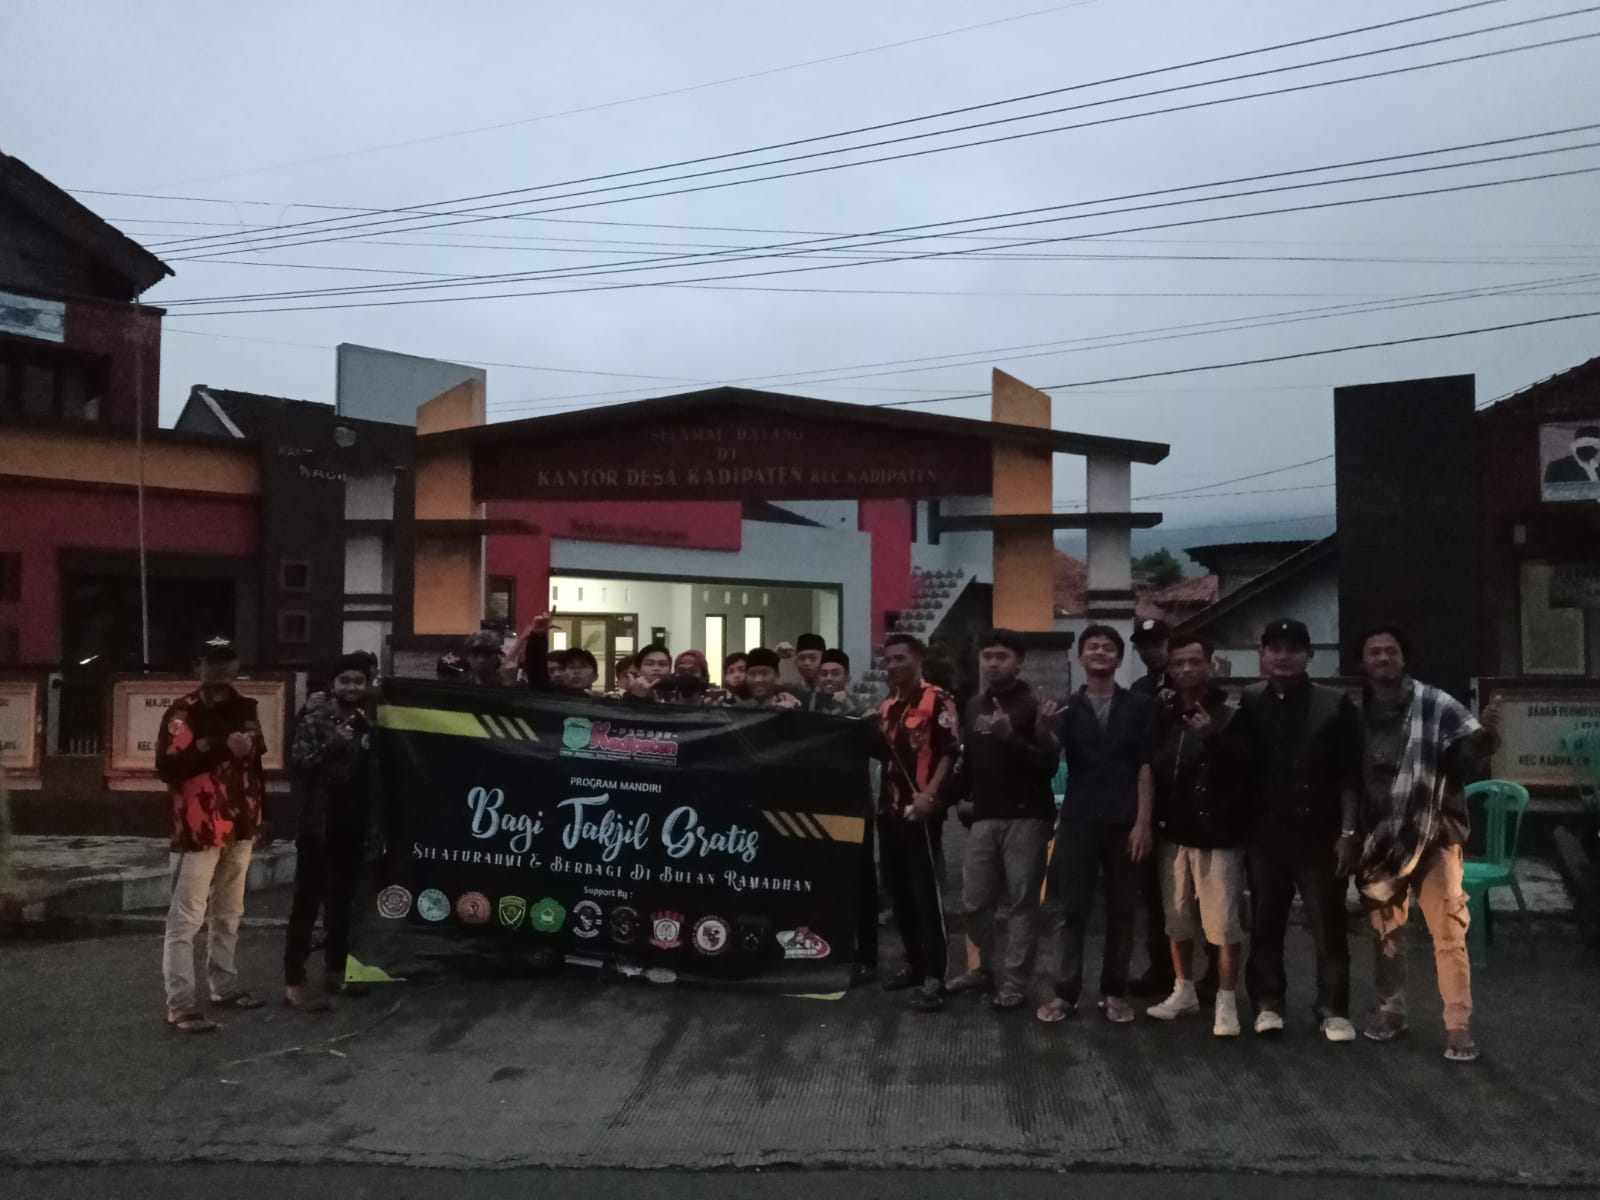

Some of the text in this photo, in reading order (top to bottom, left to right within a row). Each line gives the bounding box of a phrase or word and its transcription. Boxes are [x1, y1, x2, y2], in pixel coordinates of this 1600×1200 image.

[735, 426, 805, 441] DATANG
[716, 447, 737, 462] DI
[536, 468, 619, 488] KANTOR
[626, 468, 678, 487] DESA
[686, 465, 803, 487] KADIPATEN
[569, 776, 662, 793] PROGRAM MANDIRI
[466, 785, 760, 863] Bagi Takjil Gratis
[529, 851, 543, 869] &
[583, 885, 616, 898] Support
